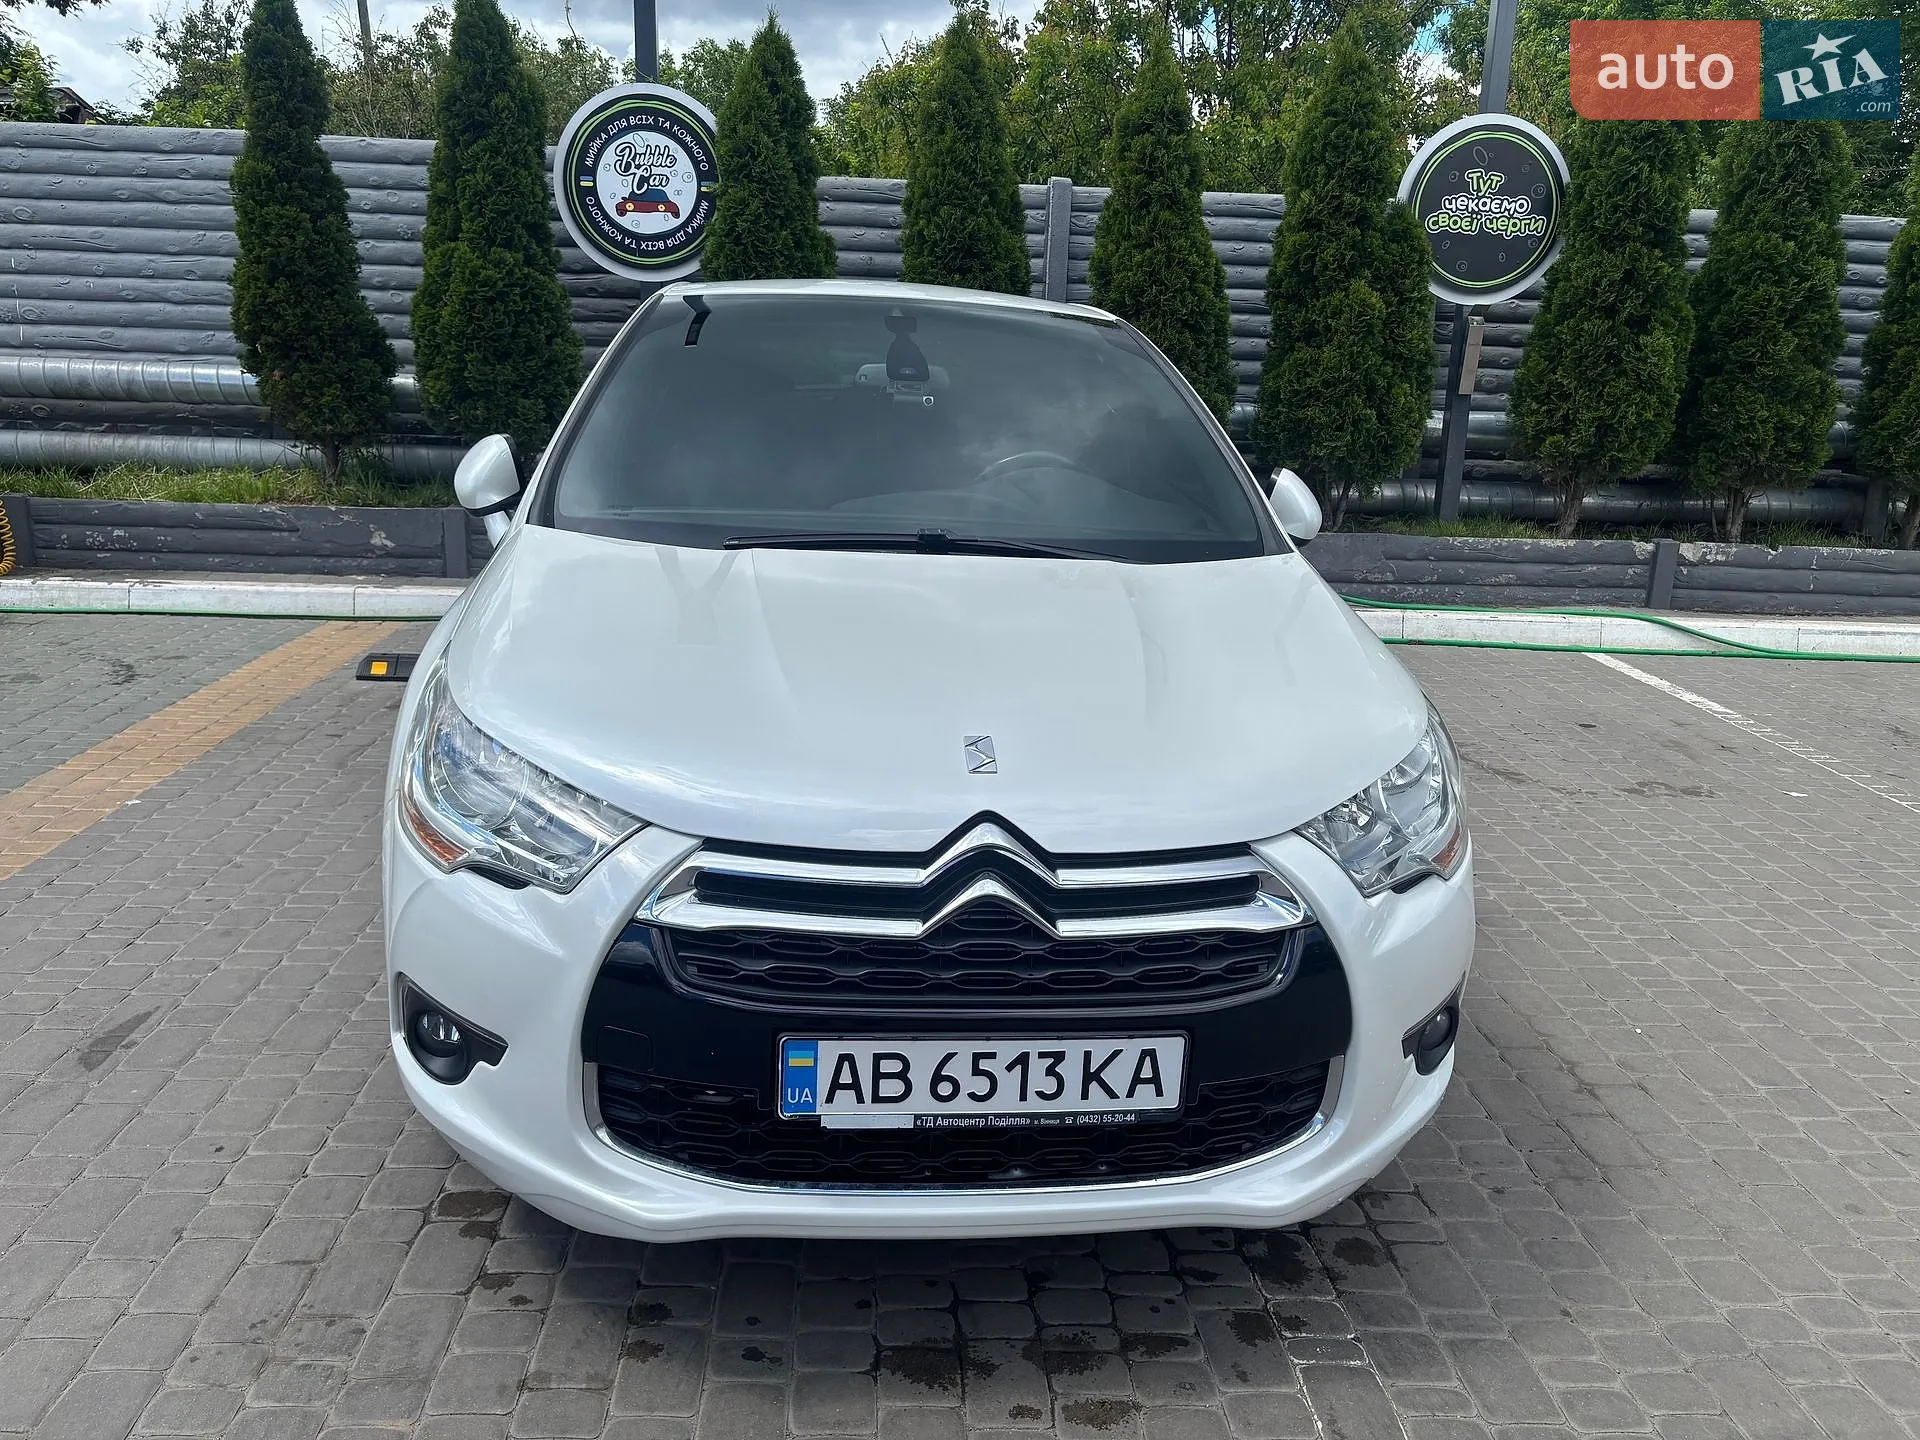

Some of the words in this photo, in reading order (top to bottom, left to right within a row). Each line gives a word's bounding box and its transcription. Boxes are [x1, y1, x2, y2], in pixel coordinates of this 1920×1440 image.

[584, 131, 611, 168] МИЙКА
[608, 118, 628, 137] ДЛЯ
[629, 115, 655, 126] ВСІХ
[657, 117, 670, 128] ТА
[672, 124, 709, 171] КОЖНОГО
[614, 141, 678, 176] Bubble
[632, 166, 670, 194] Car
[1466, 170, 1503, 196] Тут
[1443, 195, 1530, 215] чекаємо
[586, 196, 626, 243] КОЖНОГО
[1426, 212, 1483, 233] своєї
[1484, 215, 1546, 238] черги
[624, 237, 637, 248] ТА
[640, 239, 665, 250] ВСІХ
[666, 230, 687, 248] ДЛЯ
[824, 1051, 913, 1105] AB
[929, 1049, 1066, 1103] 6513
[1080, 1048, 1165, 1100] KA
[787, 1087, 813, 1104] UA
[936, 1116, 986, 1128] Автоцентр
[988, 1115, 1031, 1127] Поділля»
[1076, 1114, 1101, 1125] (0432)
[1103, 1113, 1136, 1123] 55-20-44
